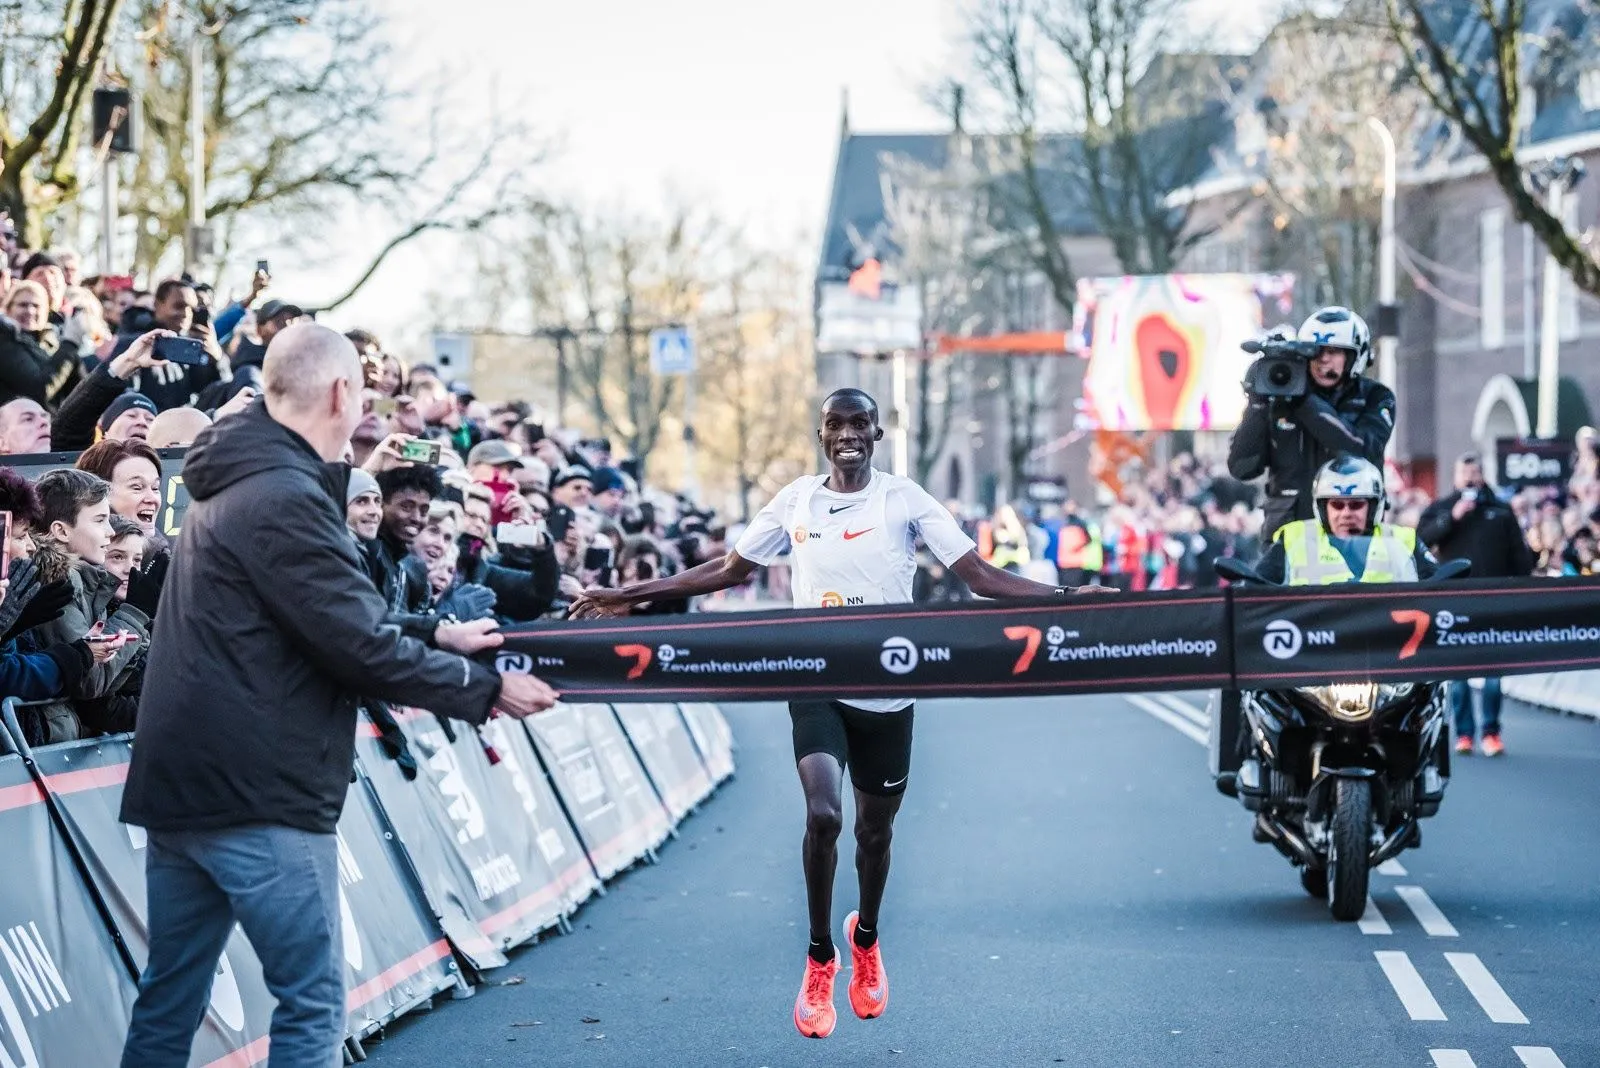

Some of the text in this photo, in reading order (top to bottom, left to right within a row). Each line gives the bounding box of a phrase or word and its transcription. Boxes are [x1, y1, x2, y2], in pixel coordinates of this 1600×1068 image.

[847, 596, 864, 605] NN
[922, 647, 951, 662] NN
[1003, 625, 1042, 674] 7
[1047, 637, 1218, 661] Zevenheuvelenloop
[1307, 630, 1336, 645] NN
[1391, 609, 1431, 660] 7
[1436, 626, 1600, 646] Zevenheuvelenloo
[614, 644, 652, 679] 7
[659, 655, 827, 674] Zevenheuvelenloop
